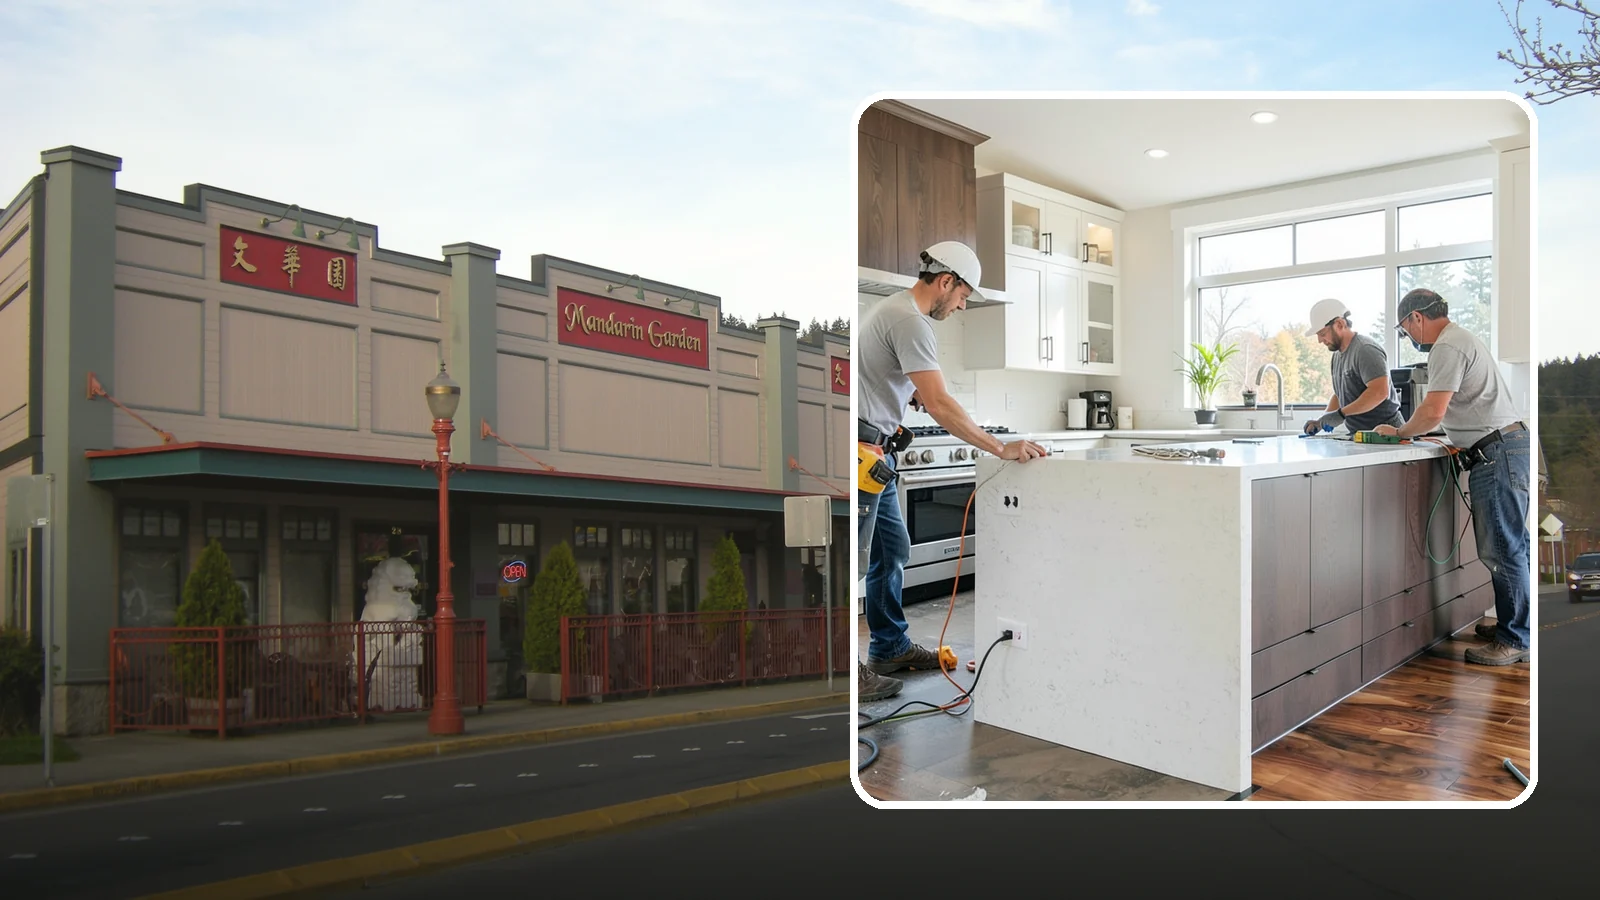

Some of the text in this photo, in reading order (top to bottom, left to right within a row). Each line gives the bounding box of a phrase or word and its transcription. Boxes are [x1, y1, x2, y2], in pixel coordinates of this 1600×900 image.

[231, 235, 346, 291] 文華園
[564, 302, 701, 352] Mandarin Garden
[503, 565, 527, 578] OPEN
